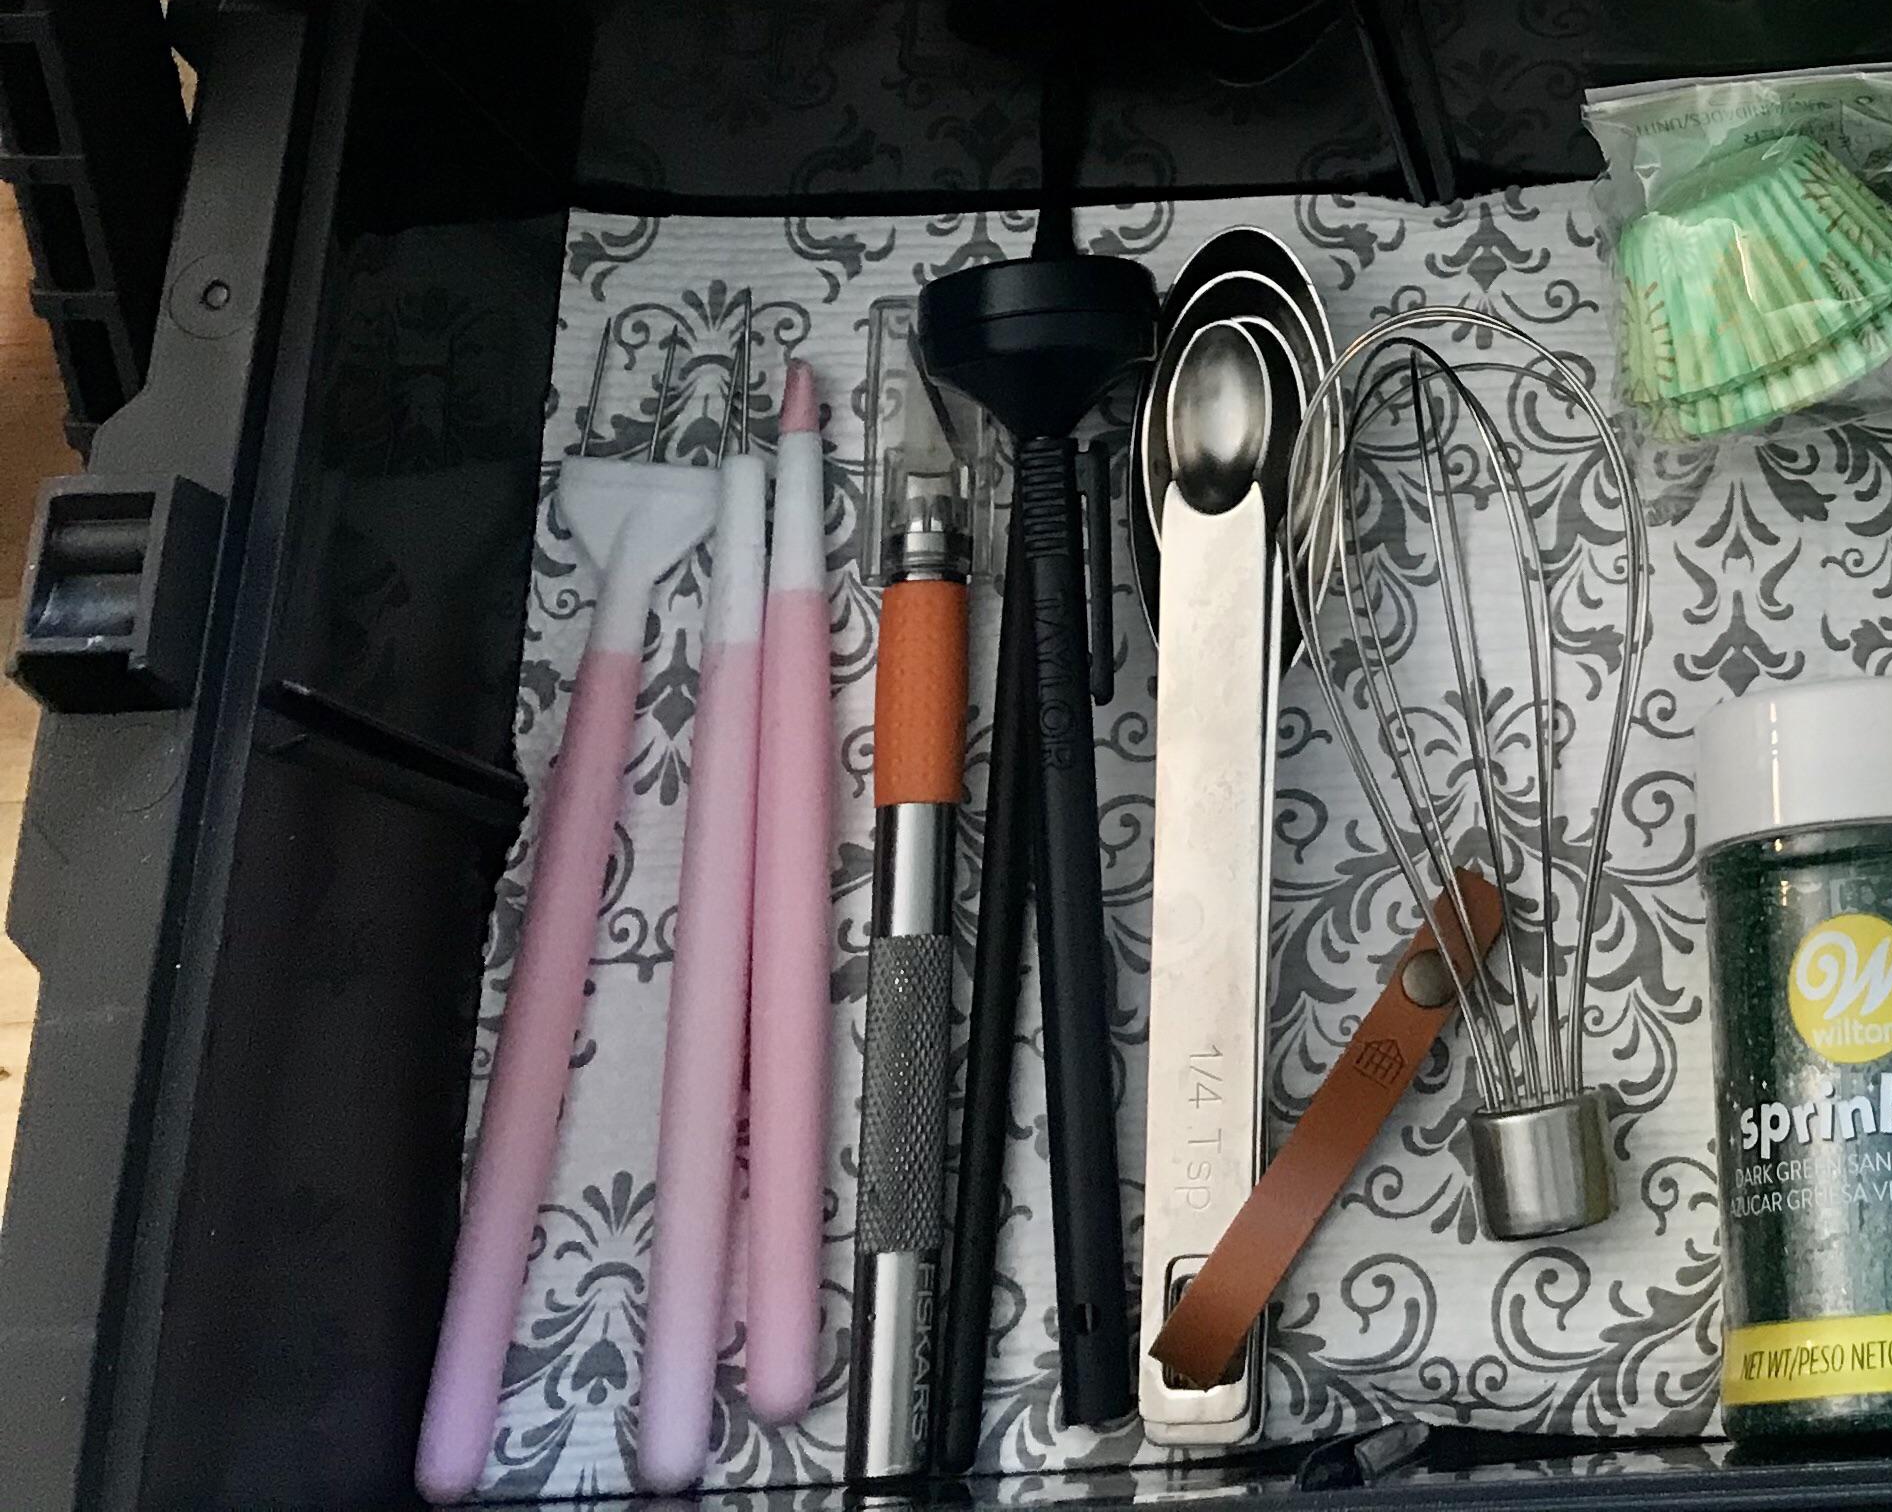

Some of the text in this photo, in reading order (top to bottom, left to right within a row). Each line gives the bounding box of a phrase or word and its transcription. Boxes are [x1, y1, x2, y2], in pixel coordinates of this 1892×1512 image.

[1034, 597, 1075, 769] TAYLOR
[1186, 1043, 1225, 1111] 1/4
[1735, 1163, 1774, 1189] DARK
[1775, 1157, 1842, 1183] GREEN
[912, 1263, 936, 1442] FISKARS
[1741, 1351, 1765, 1381] NET
[1767, 1343, 1845, 1382] WT/PESO
